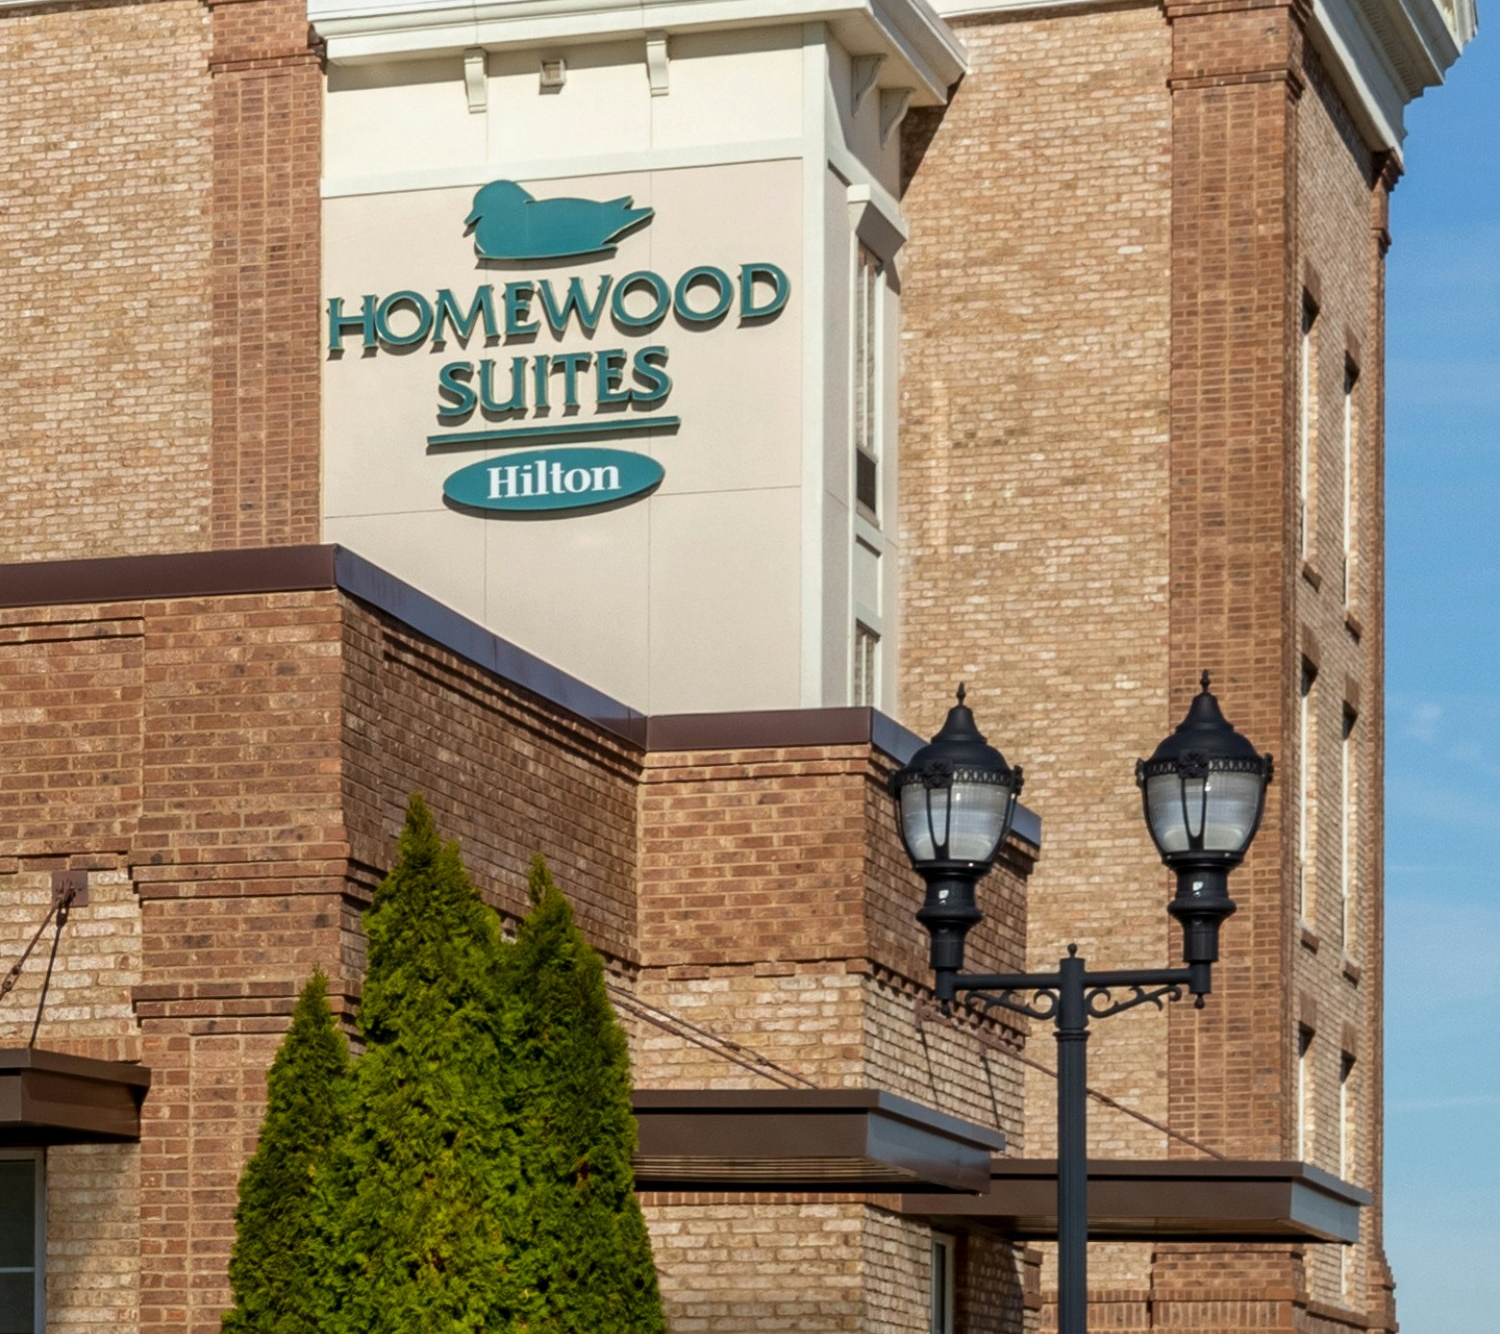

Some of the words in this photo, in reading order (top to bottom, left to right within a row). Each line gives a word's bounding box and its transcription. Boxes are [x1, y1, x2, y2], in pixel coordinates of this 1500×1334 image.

[327, 262, 790, 352] HOMEWOOD
[437, 345, 673, 419] SUITES
[486, 460, 621, 500] Hilton
